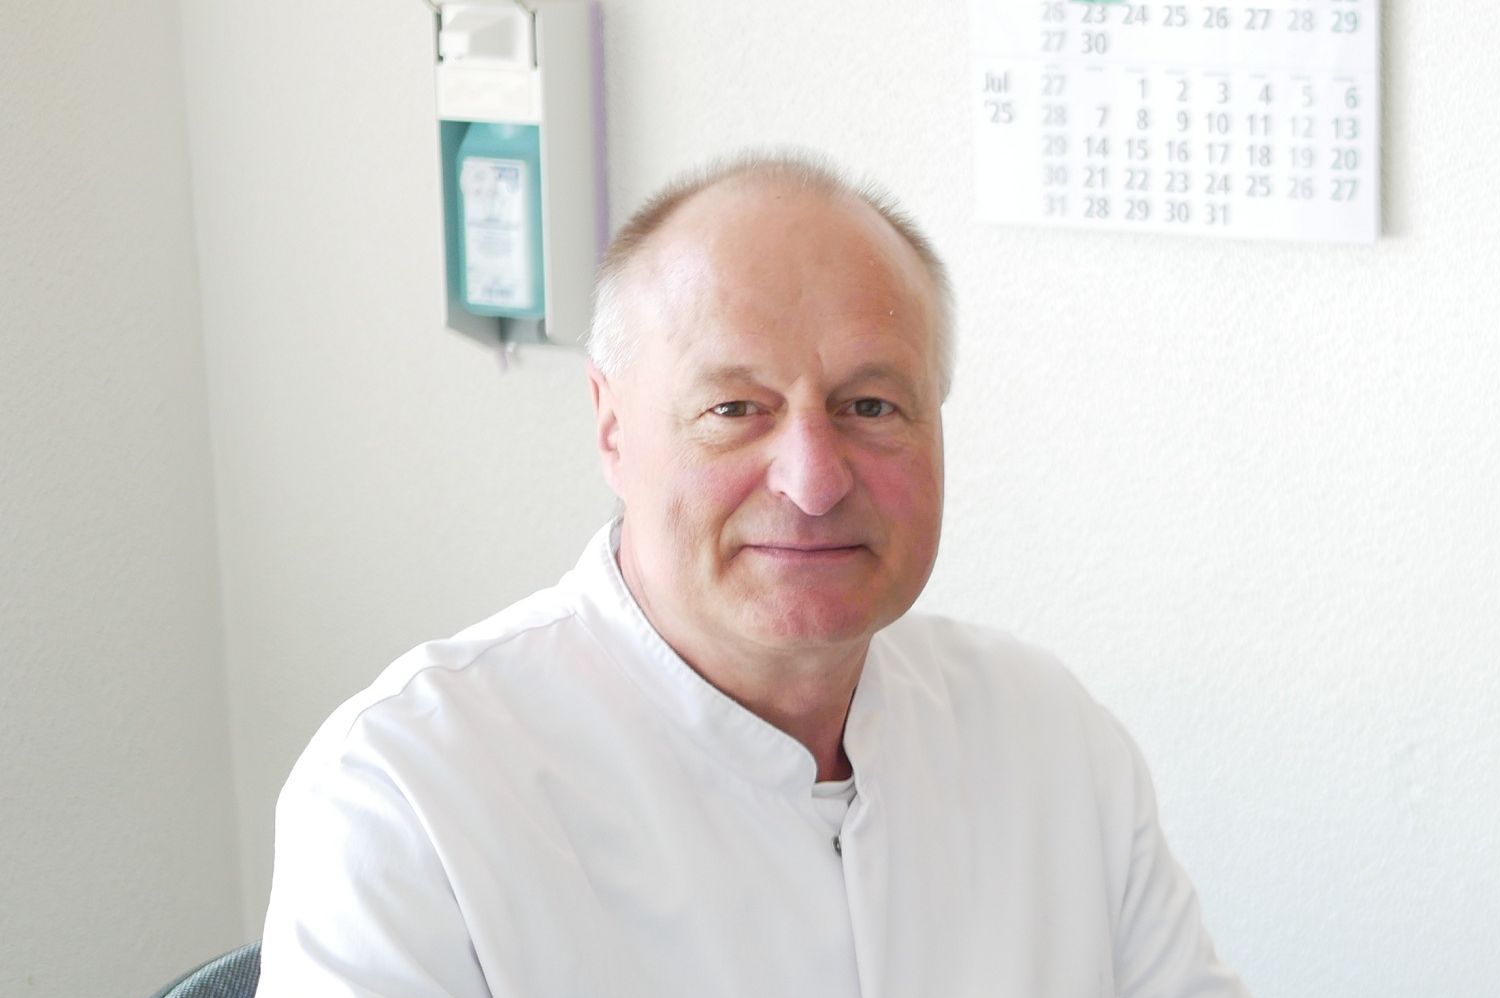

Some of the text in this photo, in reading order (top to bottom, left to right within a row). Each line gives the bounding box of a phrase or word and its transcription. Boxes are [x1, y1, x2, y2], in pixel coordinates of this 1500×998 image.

[1081, 3, 1108, 24] 23
[1121, 4, 1150, 25] 24
[1163, 4, 1190, 28] 25
[1203, 6, 1231, 30] 26
[1245, 7, 1274, 31] 27
[1331, 9, 1361, 34] 29
[1081, 30, 1109, 55] 30
[983, 71, 1010, 94] Jul
[1138, 78, 1149, 99] 1
[1176, 78, 1191, 103] 2
[1216, 80, 1232, 105] 3
[1258, 83, 1274, 106] 4
[1302, 84, 1315, 108] 5
[1344, 85, 1361, 110] 6
[1096, 105, 1110, 128] 7
[1136, 107, 1151, 131] 8
[1176, 109, 1192, 133] 9
[1206, 111, 1232, 135] 10
[1247, 113, 1273, 137] 11
[1291, 116, 1315, 139] 12
[1332, 115, 1361, 140] 13
[1084, 135, 1111, 158] 14
[1125, 137, 1150, 161] 15
[1166, 139, 1191, 163] 16
[1206, 141, 1231, 165] 17
[1247, 143, 1274, 168] 18
[1290, 145, 1317, 169] 19
[1330, 147, 1361, 172] 20
[1084, 165, 1109, 189] 21
[1125, 167, 1151, 191] 22
[1165, 169, 1192, 193] 23
[1205, 171, 1232, 195] 24
[1246, 173, 1273, 198] 25
[1289, 176, 1315, 199] 26
[1330, 176, 1360, 202] 27
[1084, 194, 1111, 219] 28
[1125, 197, 1152, 221] 29
[1166, 199, 1192, 223] 30
[1206, 201, 1230, 225] 31
